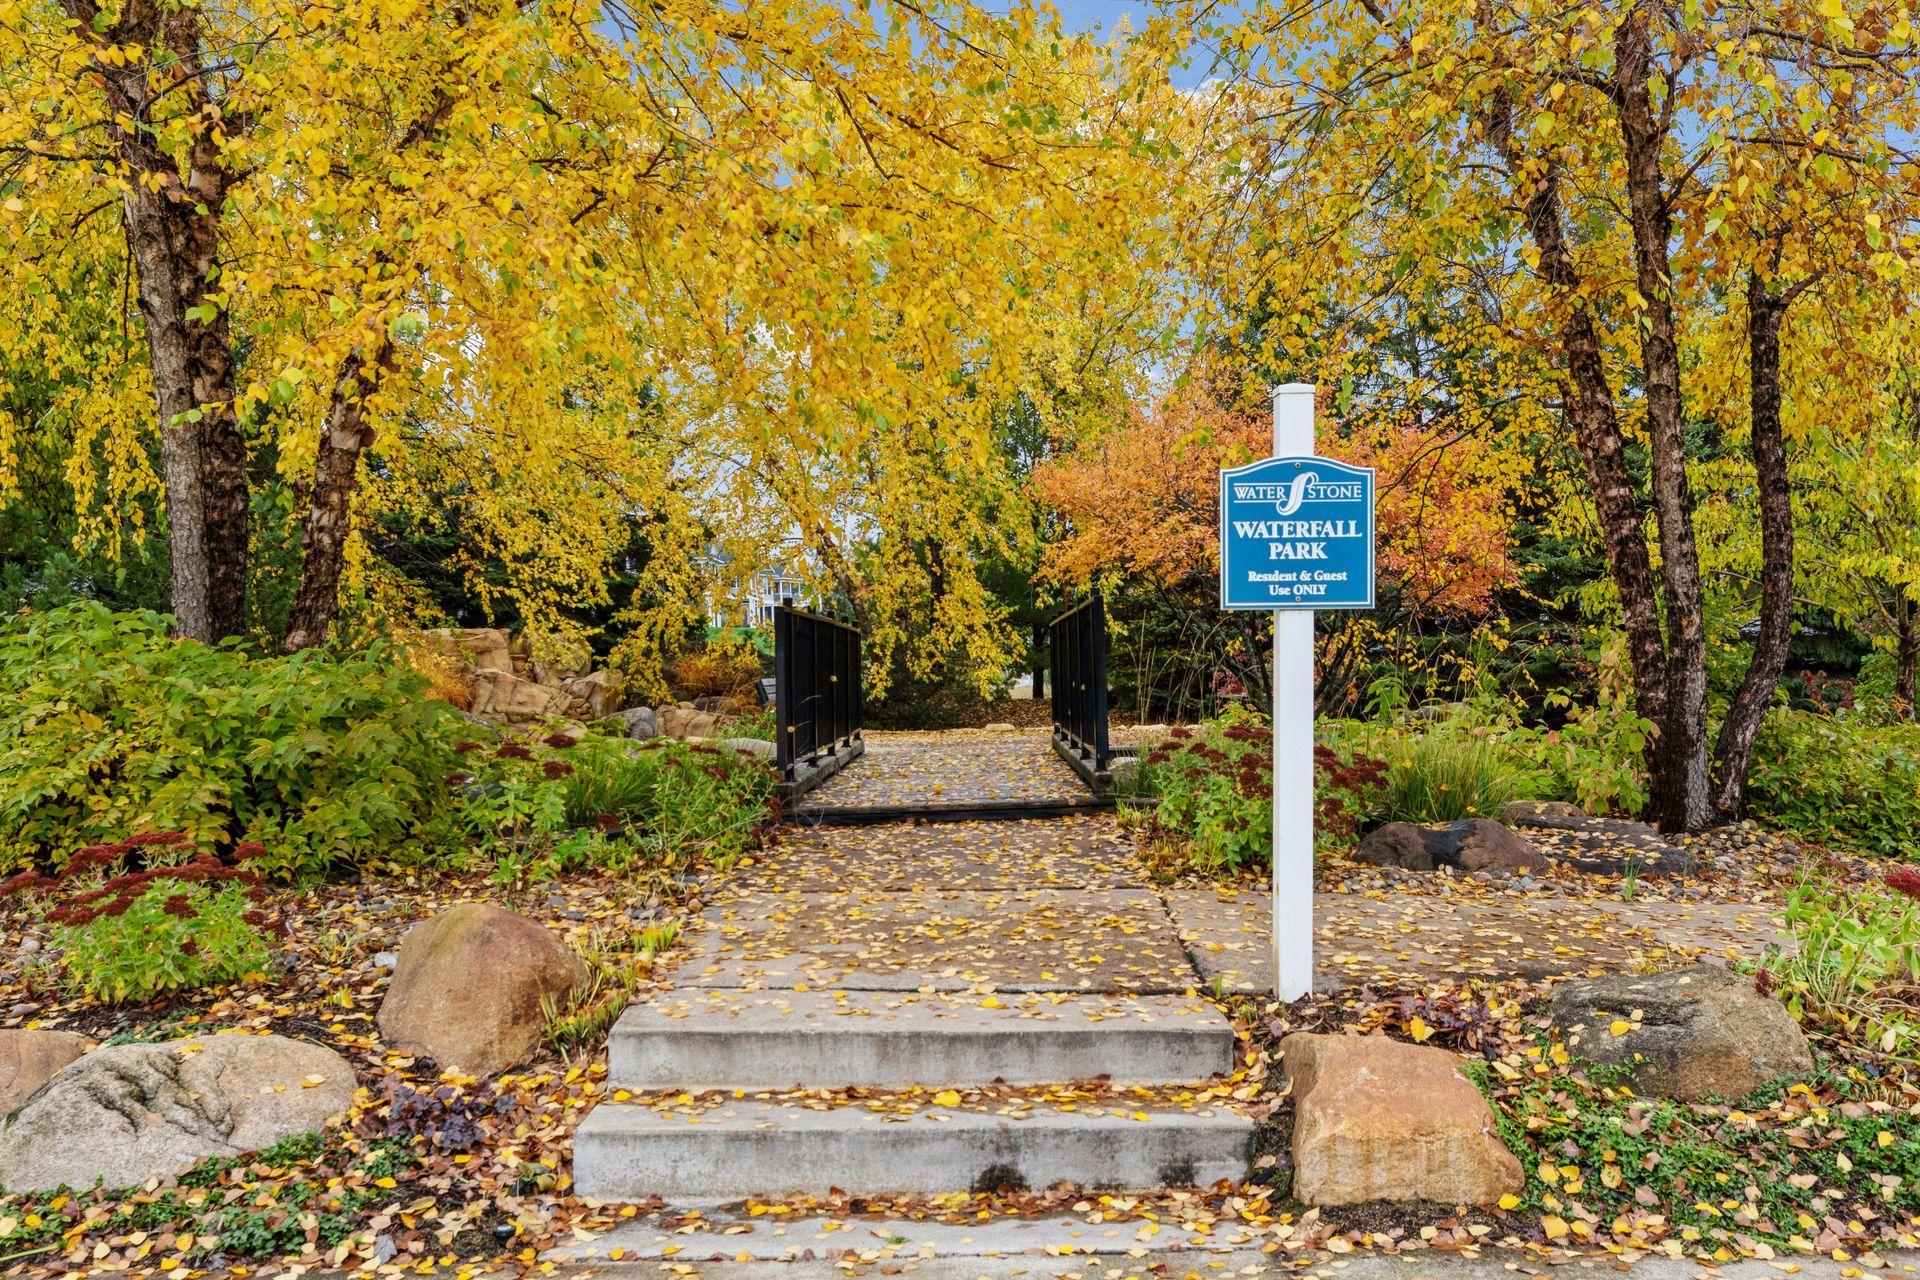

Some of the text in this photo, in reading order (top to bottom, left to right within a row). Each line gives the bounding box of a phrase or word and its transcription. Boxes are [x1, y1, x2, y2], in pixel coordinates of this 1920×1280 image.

[1234, 485, 1362, 499] WATER STONE
[1233, 520, 1362, 538] WATERFALL
[1269, 542, 1328, 559] PARK
[1248, 570, 1348, 582] Resident & Guest
[1269, 584, 1327, 596] Use ONLY
